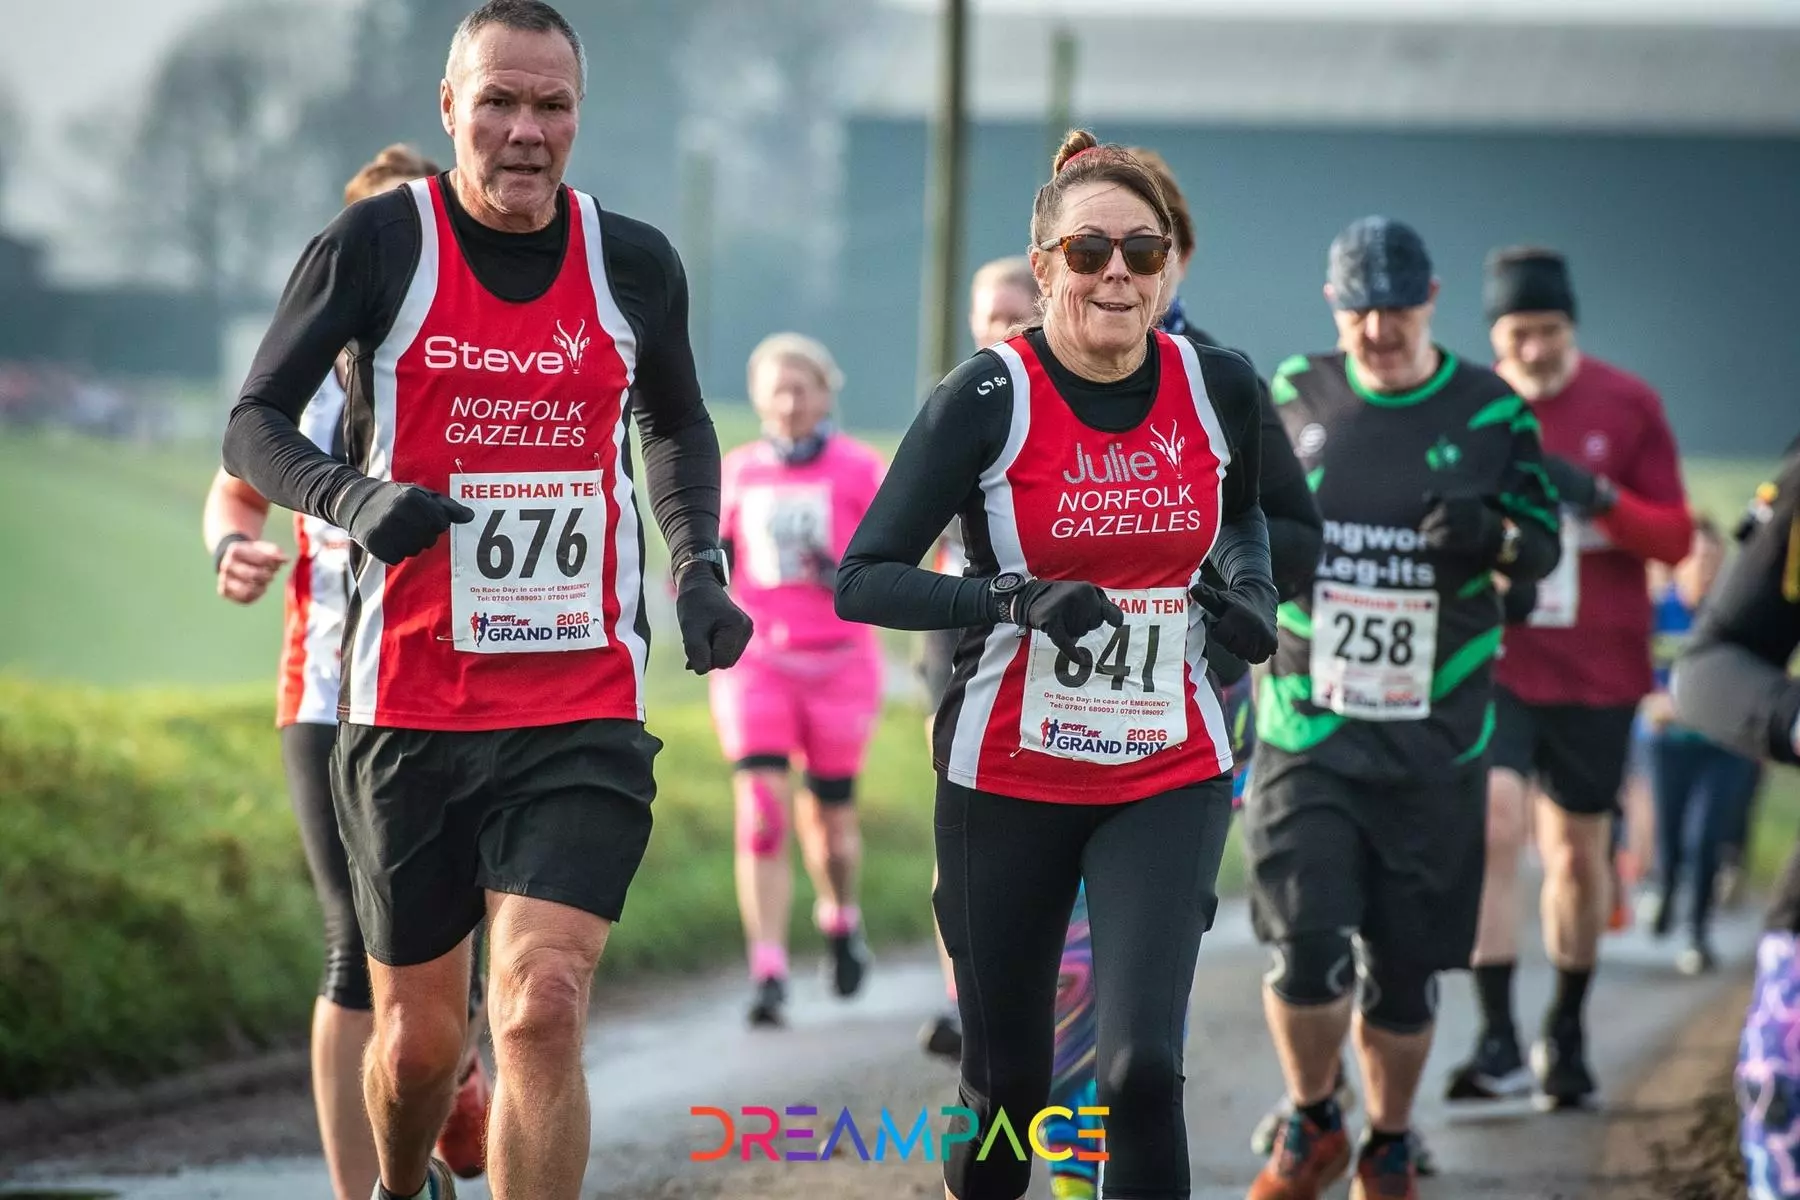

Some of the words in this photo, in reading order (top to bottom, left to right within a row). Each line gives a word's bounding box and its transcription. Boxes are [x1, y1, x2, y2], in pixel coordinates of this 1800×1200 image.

[424, 335, 564, 374] Steve
[450, 397, 586, 421] NORFOLK
[445, 423, 586, 447] GAZELLES
[1063, 443, 1158, 484] Julie
[460, 483, 564, 499] REEDHAM
[1057, 484, 1195, 513] NORFOLK
[1051, 510, 1201, 539] GAZELLES
[476, 508, 588, 580] 676
[1111, 598, 1147, 614] AM
[1152, 599, 1184, 614] TEN
[490, 614, 517, 622] SPORT
[511, 618, 531, 626] LINK
[556, 611, 589, 626] 2026
[488, 627, 553, 641] GRAND
[556, 624, 591, 640] PRIX
[1333, 611, 1414, 666] 258
[1054, 624, 1161, 693] 641
[1055, 693, 1074, 702] Race
[1076, 695, 1092, 704] Day:
[1129, 700, 1171, 708] EMERGENCY
[1059, 722, 1087, 732] SPORT
[1082, 729, 1102, 738] LINK
[1126, 728, 1168, 742] 2026
[1056, 735, 1122, 754] GRAND
[1125, 742, 1167, 755] PRIX
